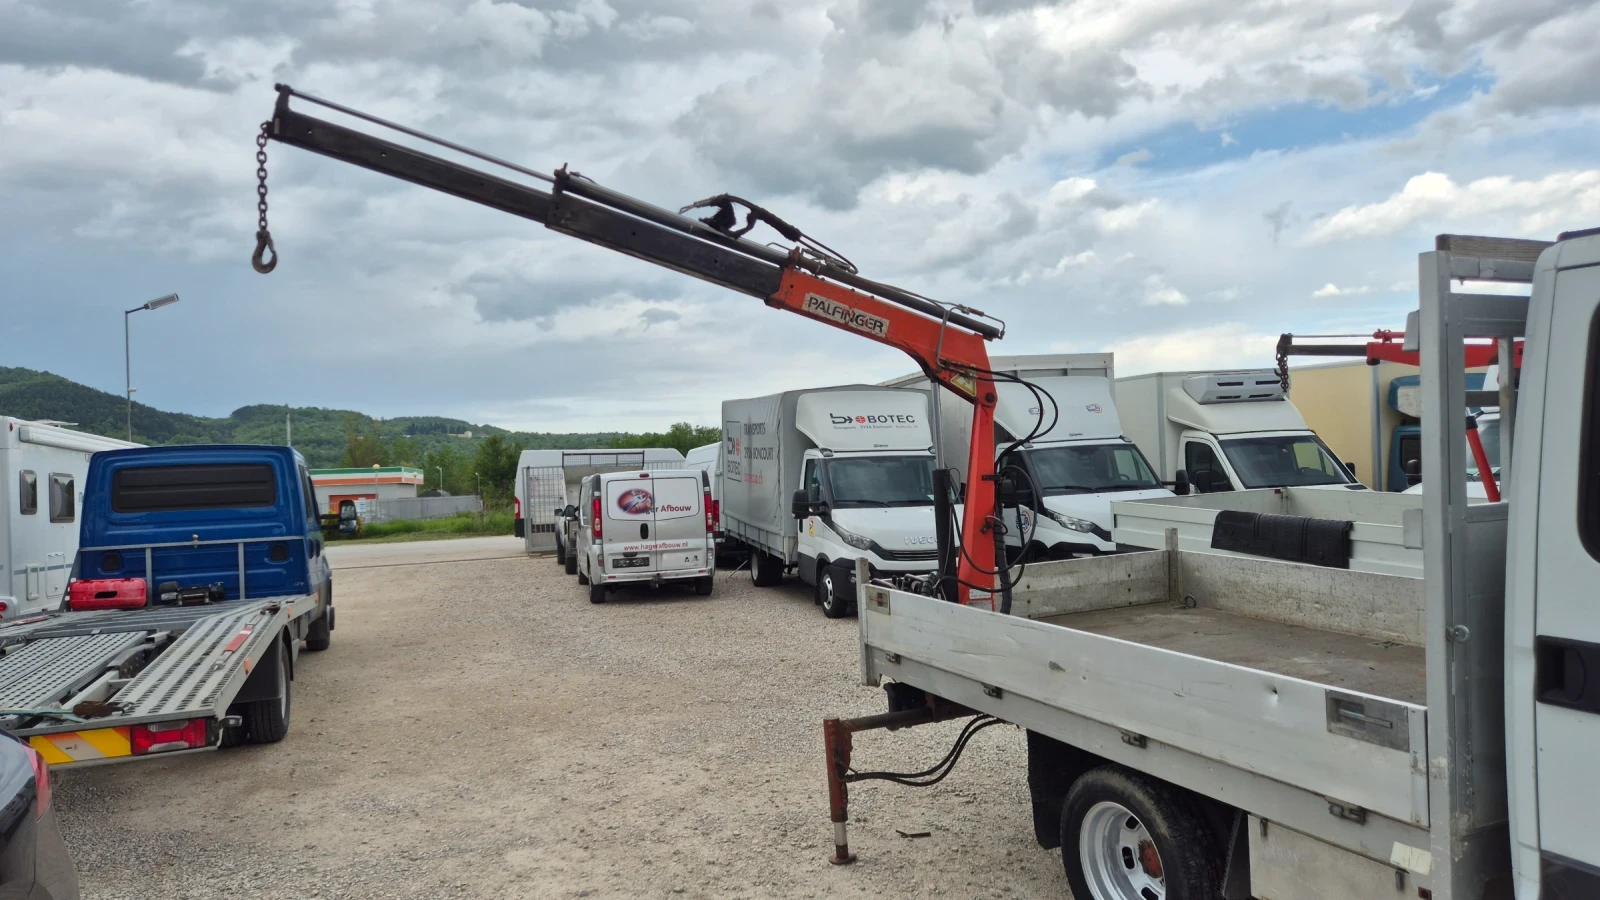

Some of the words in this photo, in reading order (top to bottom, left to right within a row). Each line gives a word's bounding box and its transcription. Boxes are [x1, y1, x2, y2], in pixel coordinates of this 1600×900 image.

[807, 296, 884, 333] PALFINGER
[867, 414, 916, 424] BOTEC
[727, 460, 741, 475] BOTEC
[660, 504, 692, 512] Afbouw
[623, 541, 689, 551] www.hagerafbouw.nl
